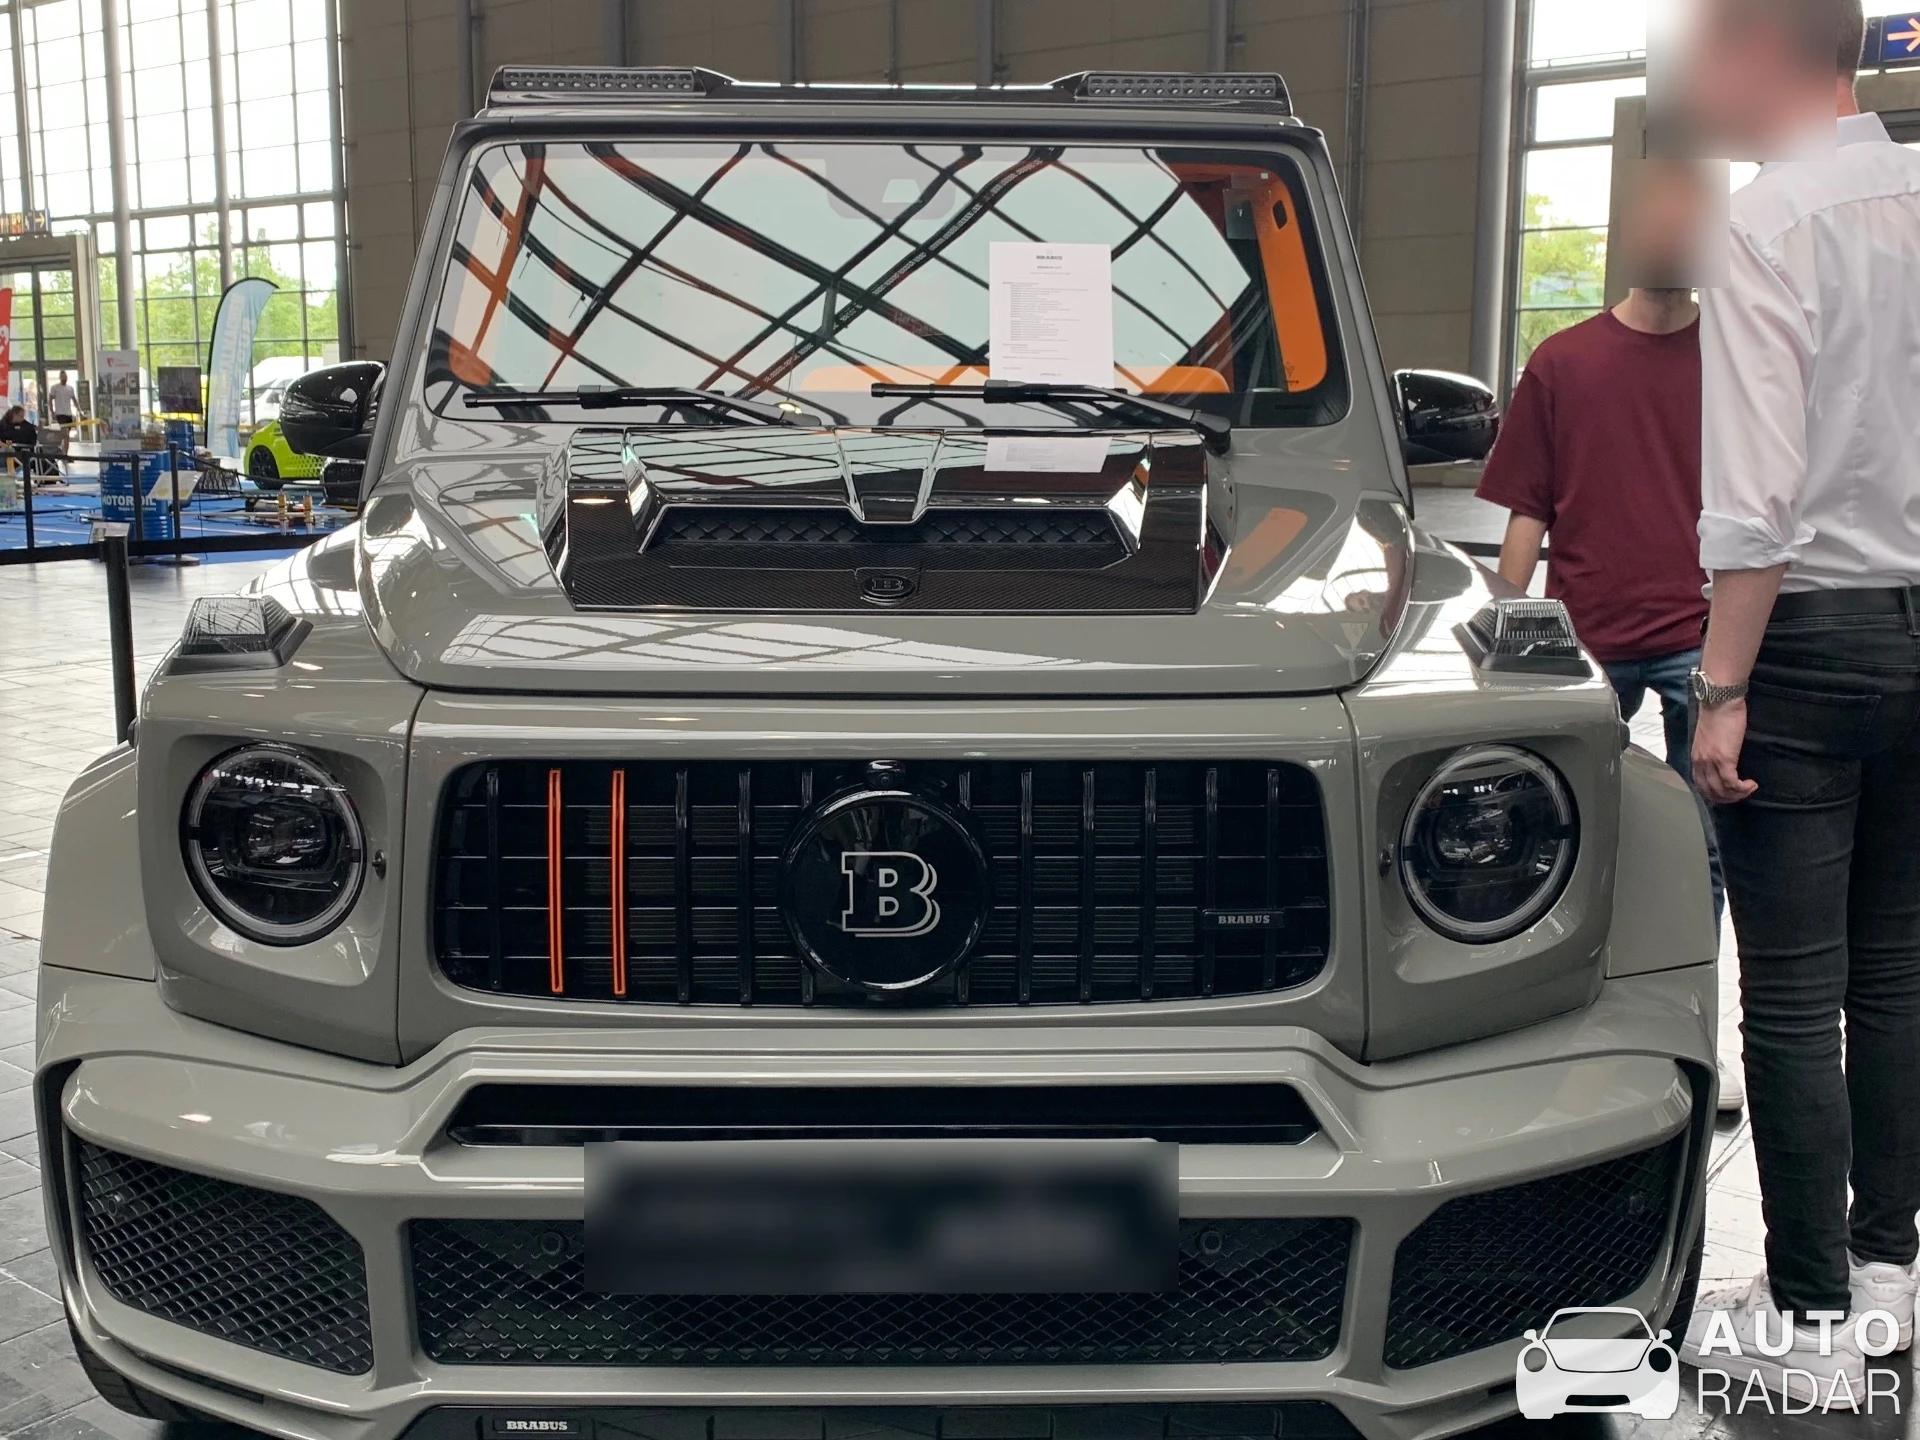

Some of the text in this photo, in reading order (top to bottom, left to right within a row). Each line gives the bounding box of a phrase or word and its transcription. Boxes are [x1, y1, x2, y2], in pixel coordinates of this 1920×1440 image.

[872, 578, 904, 591] B
[841, 851, 941, 938] B
[1218, 915, 1271, 924] BRABUS
[506, 1420, 568, 1431] BRABUS
